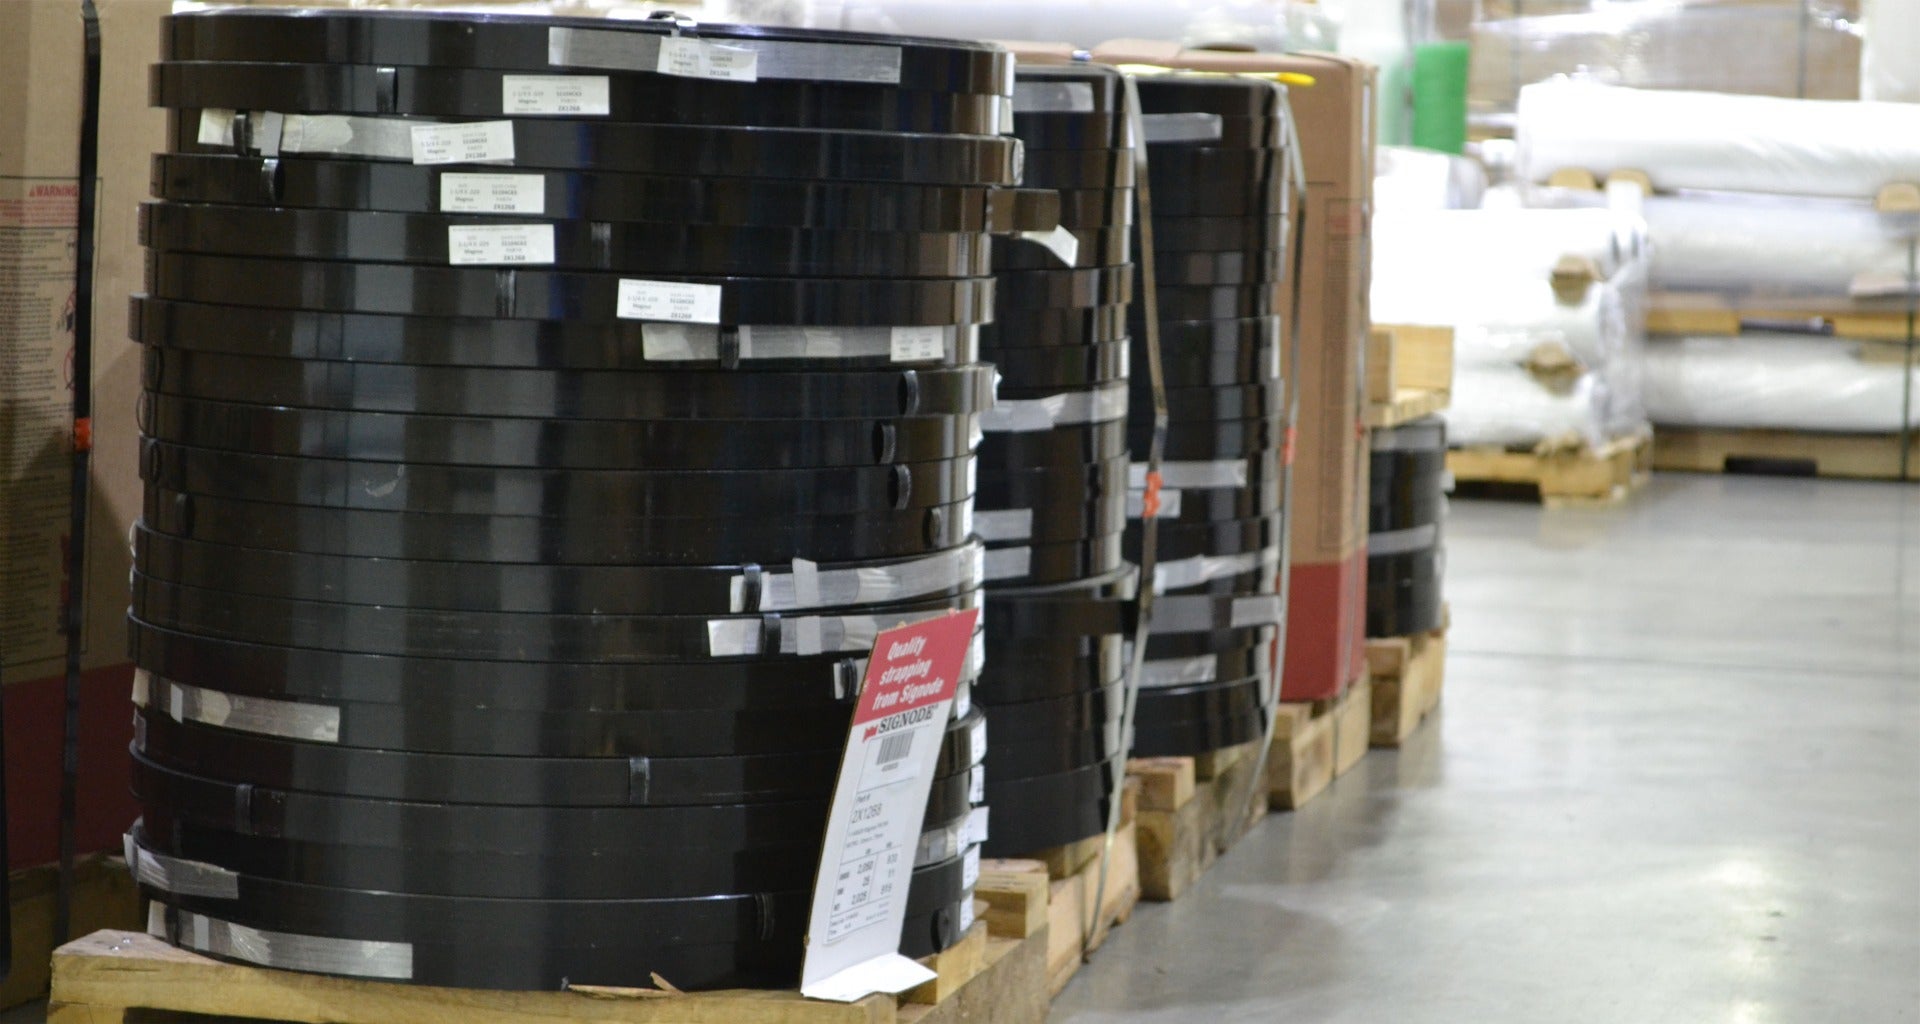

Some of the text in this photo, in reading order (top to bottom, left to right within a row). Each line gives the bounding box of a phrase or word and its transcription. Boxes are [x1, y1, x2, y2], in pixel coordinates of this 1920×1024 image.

[887, 636, 928, 661] Quality
[879, 659, 933, 685] strapping
[872, 677, 945, 711] from Signode
